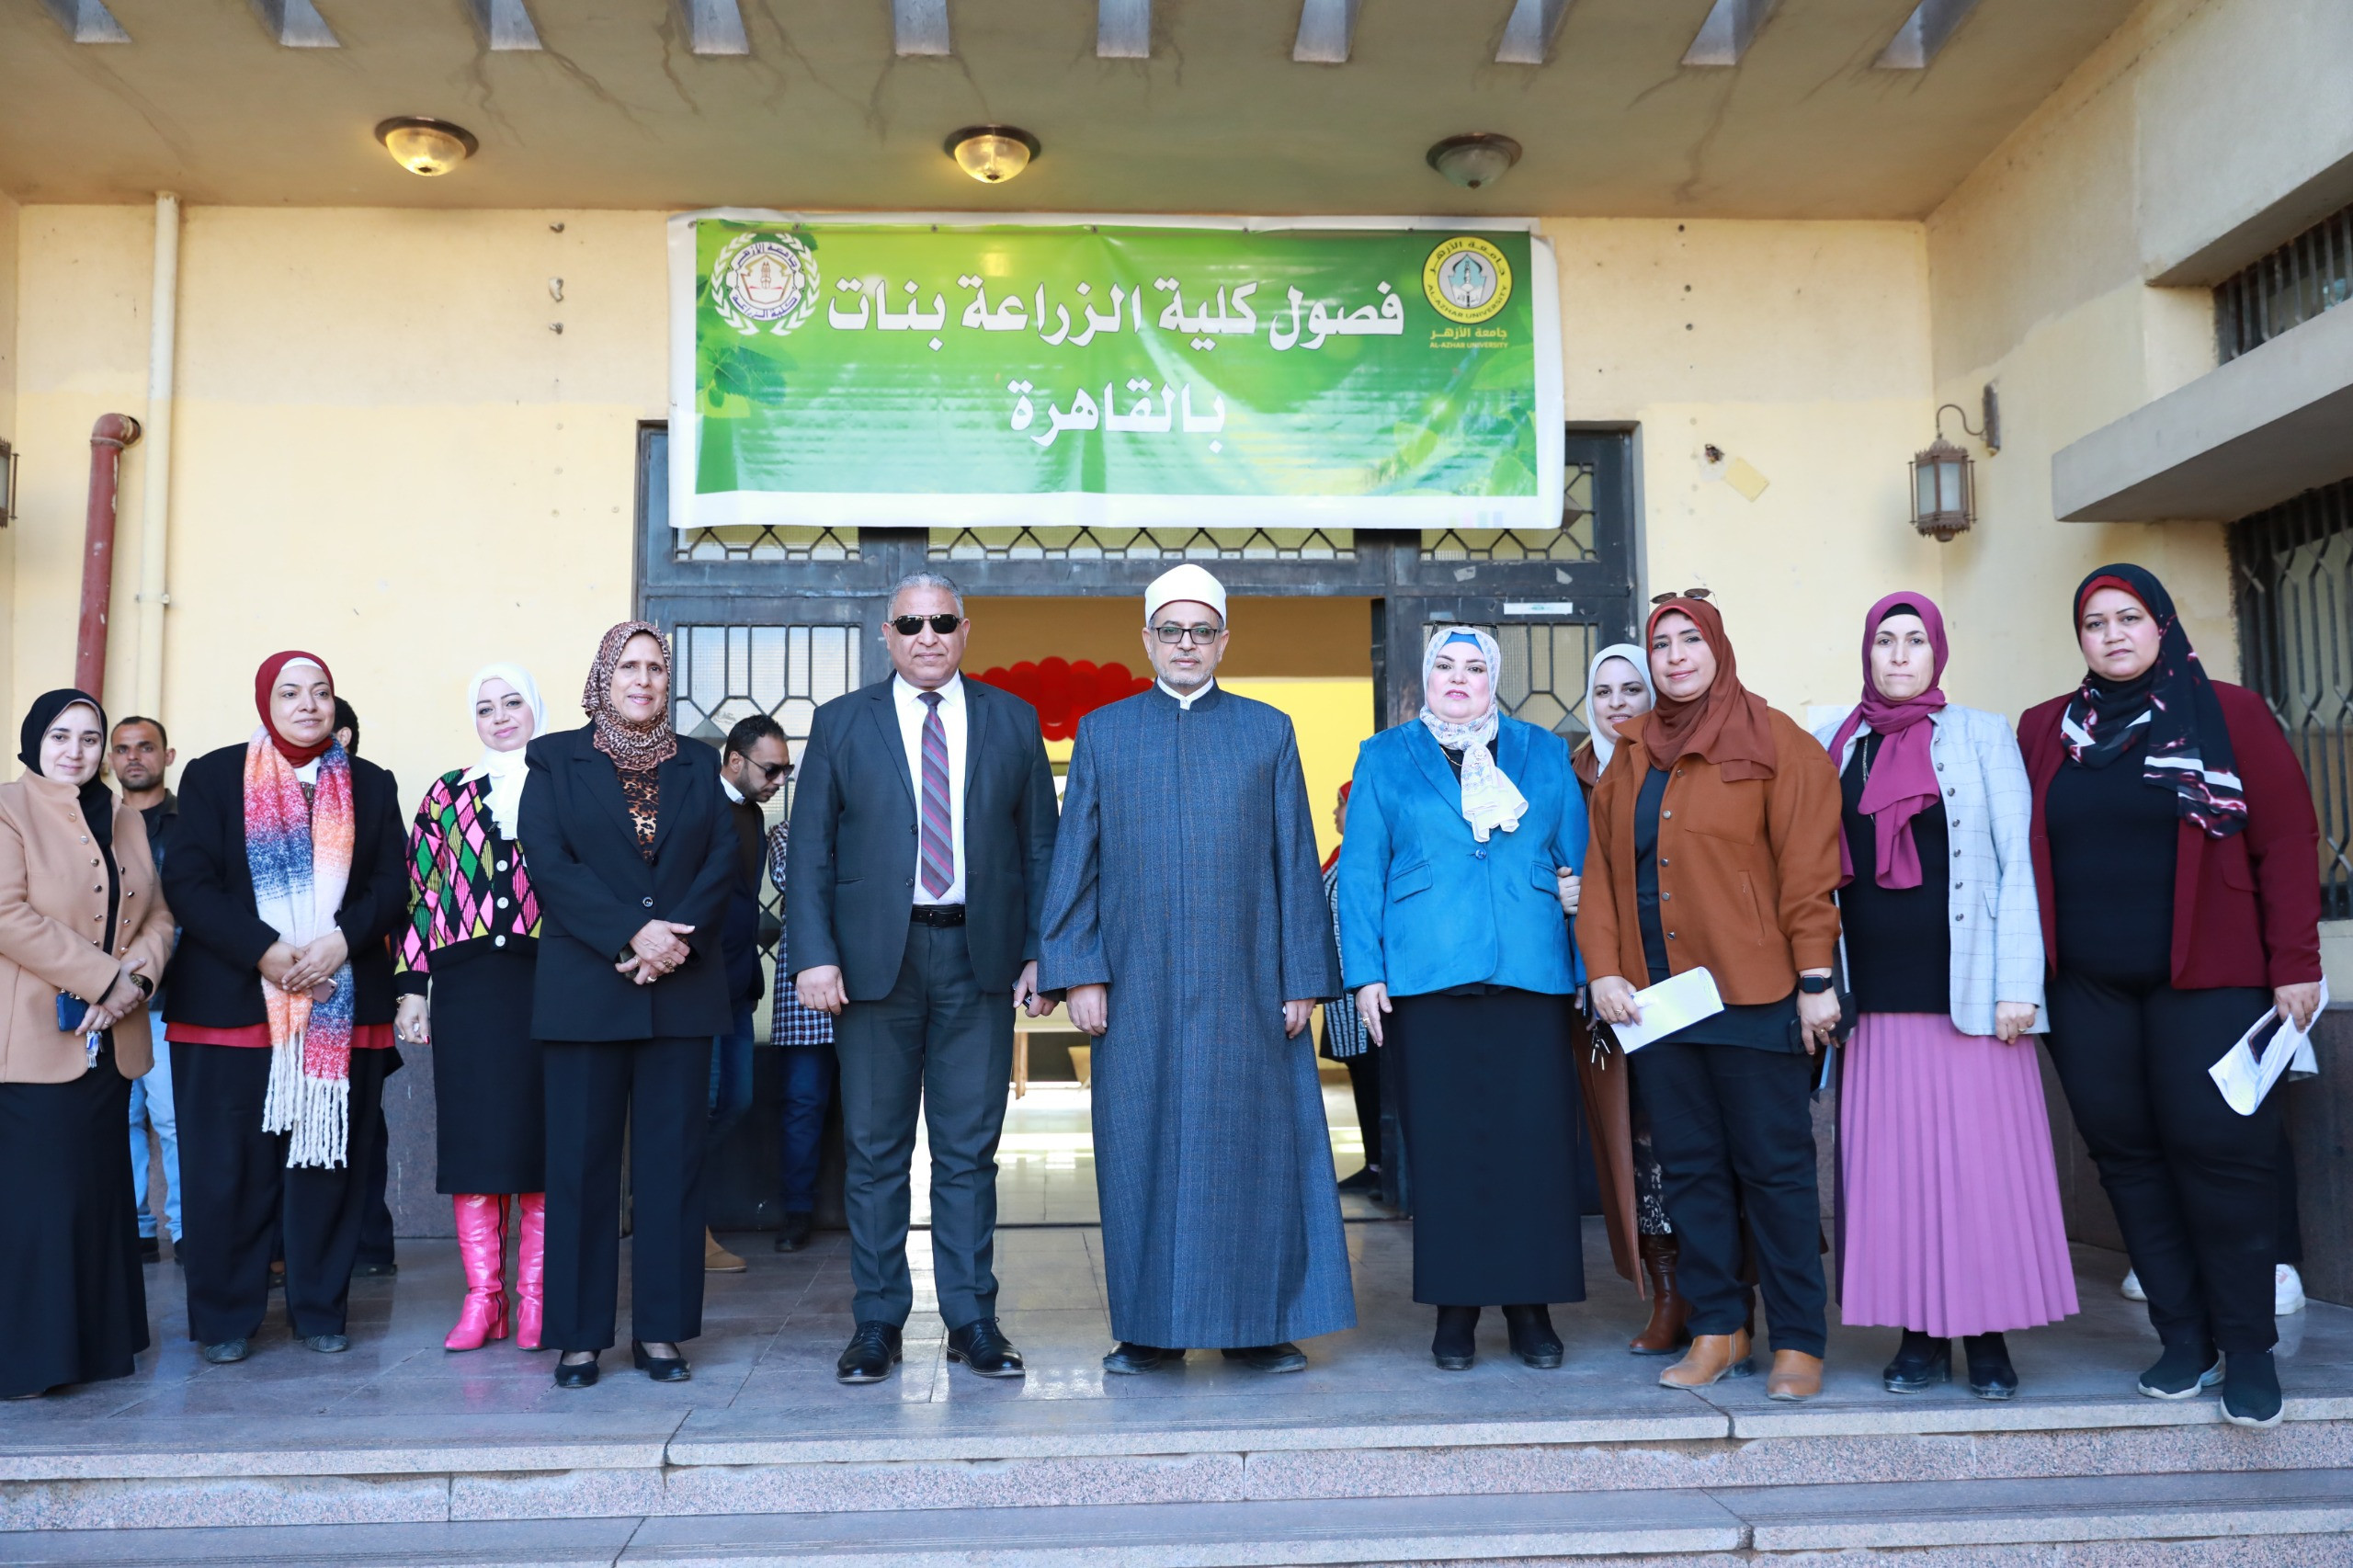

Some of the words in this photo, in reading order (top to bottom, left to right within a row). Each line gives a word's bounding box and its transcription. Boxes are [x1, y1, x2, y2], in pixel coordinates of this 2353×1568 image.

[827, 276, 948, 353] بنات
[956, 273, 1142, 347] الزراعة
[1153, 276, 1258, 352] كلية
[1268, 279, 1404, 351] فصول
[1465, 285, 1507, 319] UNIVERSITY
[1475, 326, 1507, 341] جامعة
[1429, 341, 1465, 349] AL-AZHAR
[1467, 341, 1508, 349] UNIVERSITY
[1006, 377, 1226, 454] بالقاهرة
